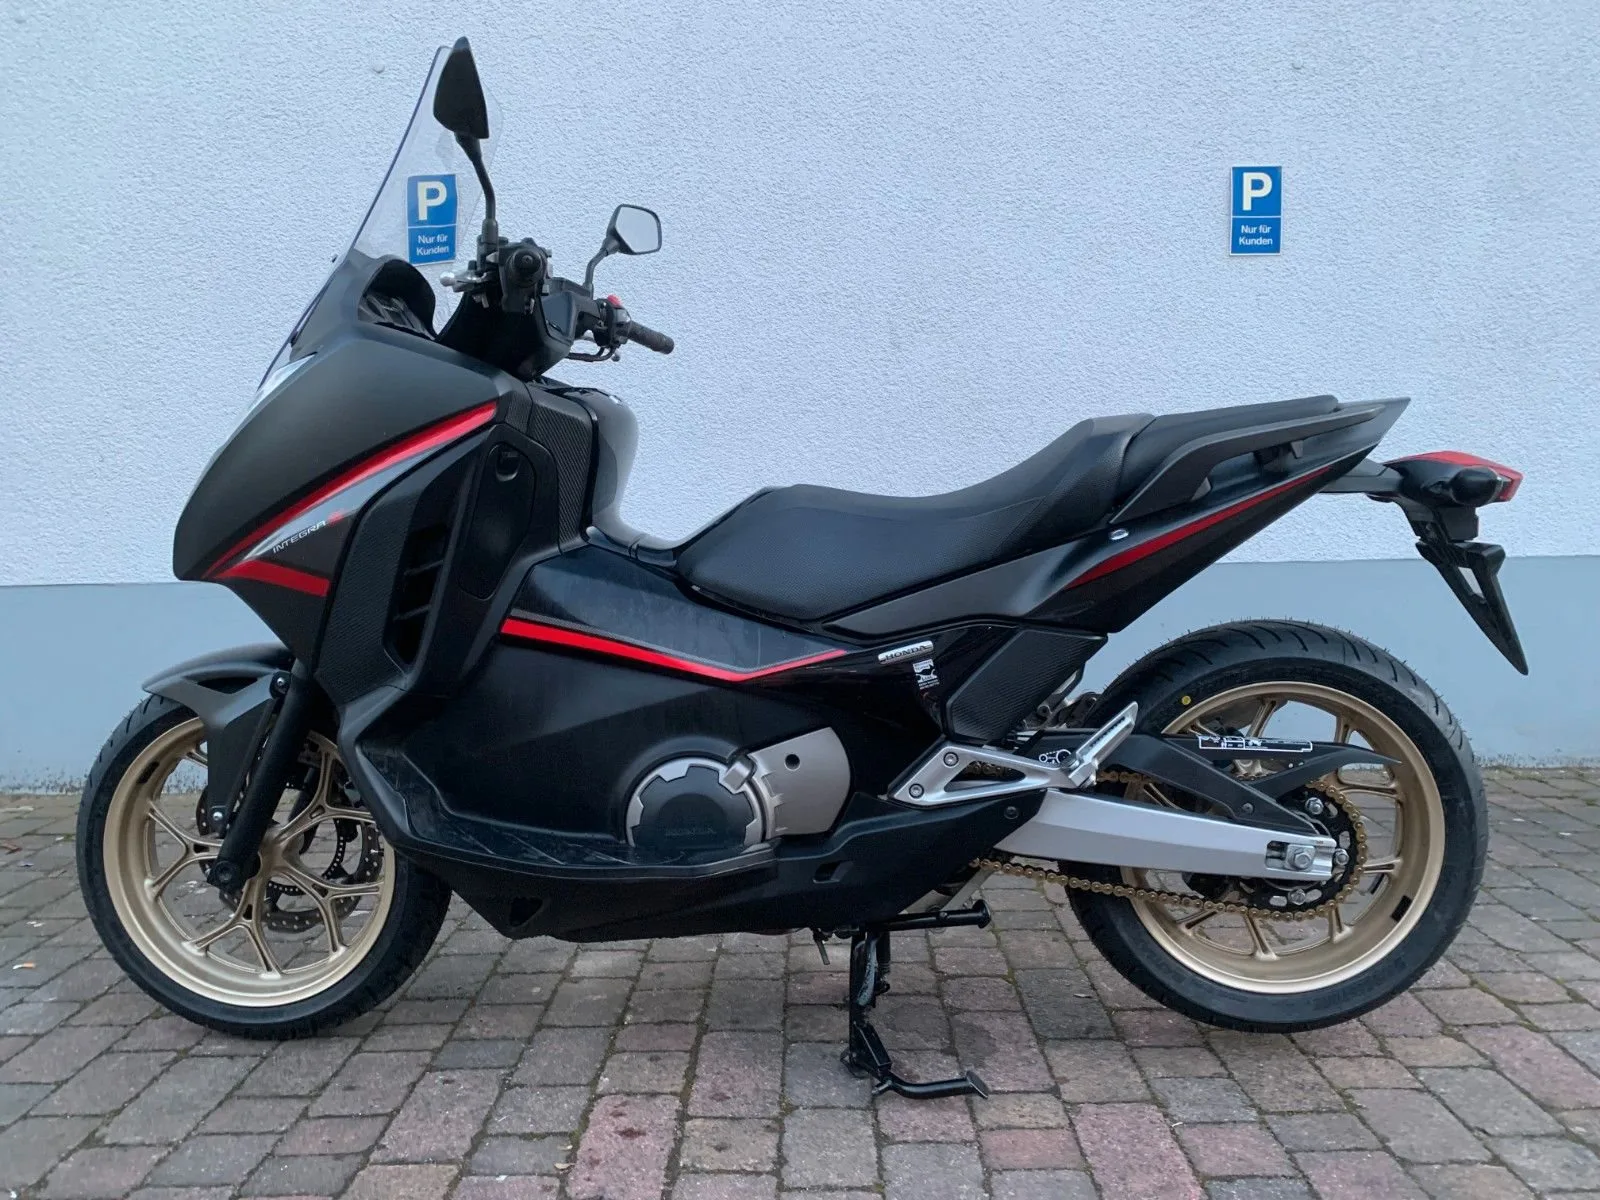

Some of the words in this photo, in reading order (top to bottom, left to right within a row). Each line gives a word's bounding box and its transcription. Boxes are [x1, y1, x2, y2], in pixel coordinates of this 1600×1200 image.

[1242, 172, 1273, 211] P
[417, 181, 448, 221] P
[1241, 225, 1257, 234] Nur
[1259, 224, 1272, 234] für
[418, 235, 434, 244] Nur
[436, 233, 449, 243] für
[1239, 236, 1273, 246] Kunden
[416, 245, 450, 256] Kunden
[272, 520, 327, 554] INTEGRA
[885, 645, 927, 660] HONDA
